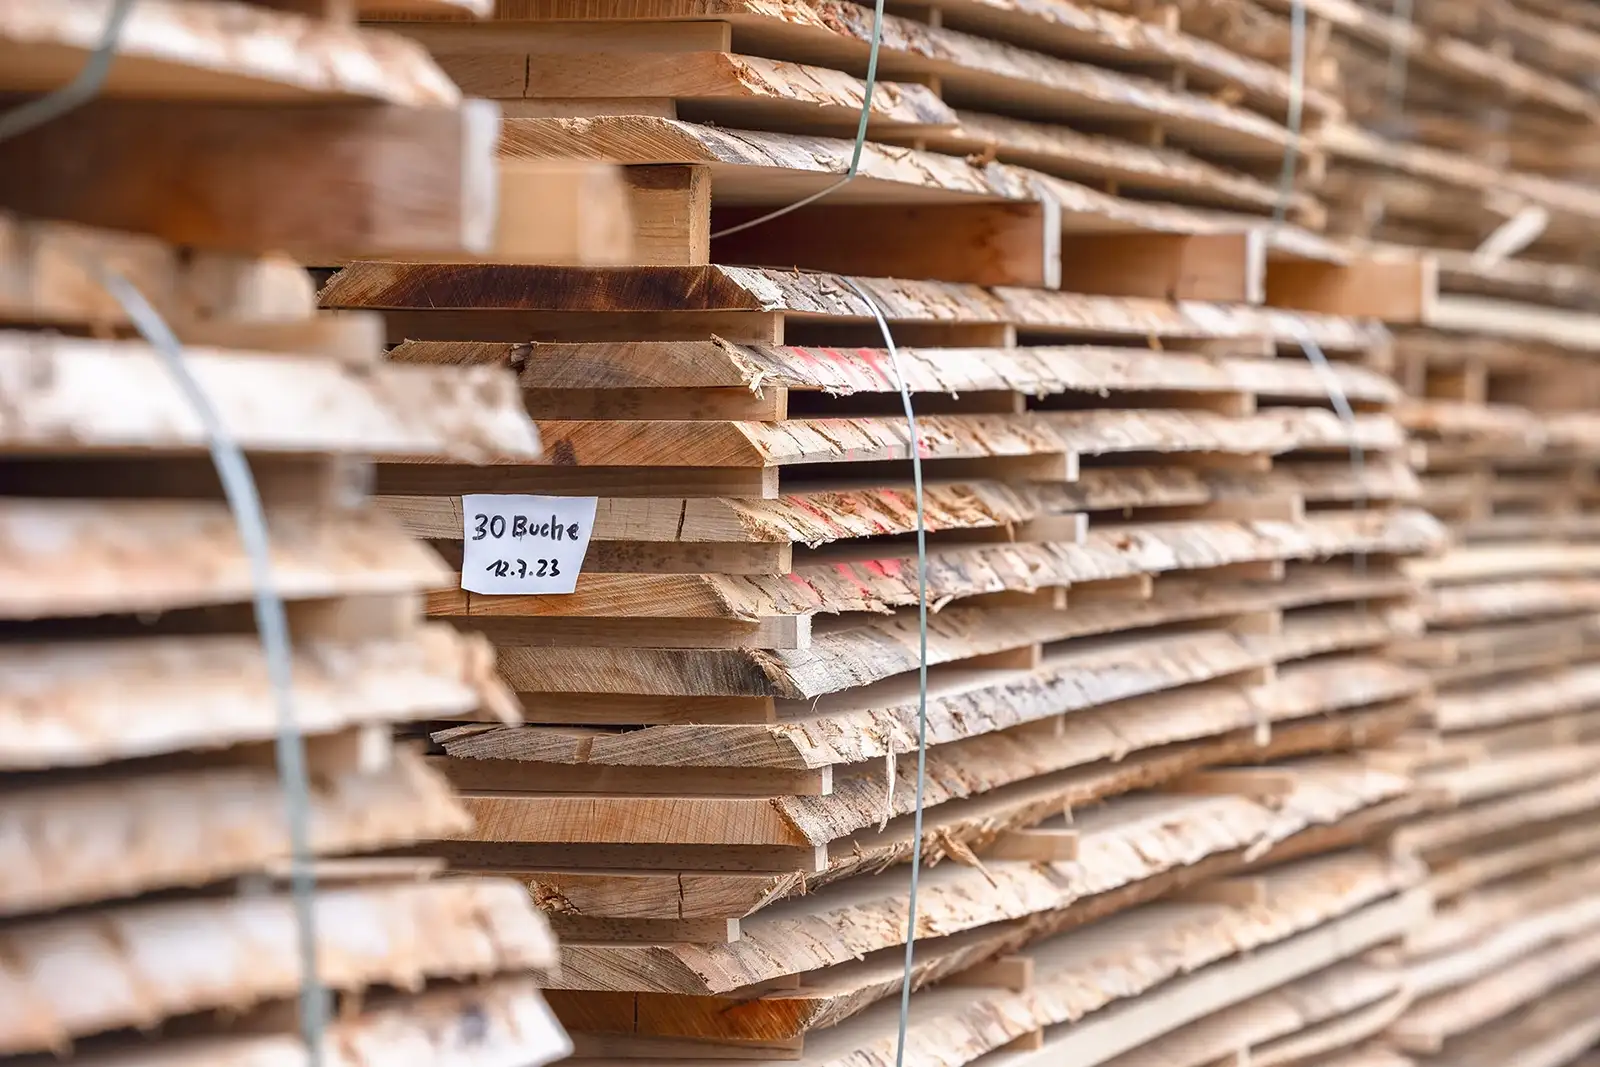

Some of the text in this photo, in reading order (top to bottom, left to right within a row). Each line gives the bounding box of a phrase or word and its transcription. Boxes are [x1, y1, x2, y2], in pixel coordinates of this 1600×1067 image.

[473, 513, 580, 541] 30 Buche
[485, 557, 562, 579] 12.7.23
